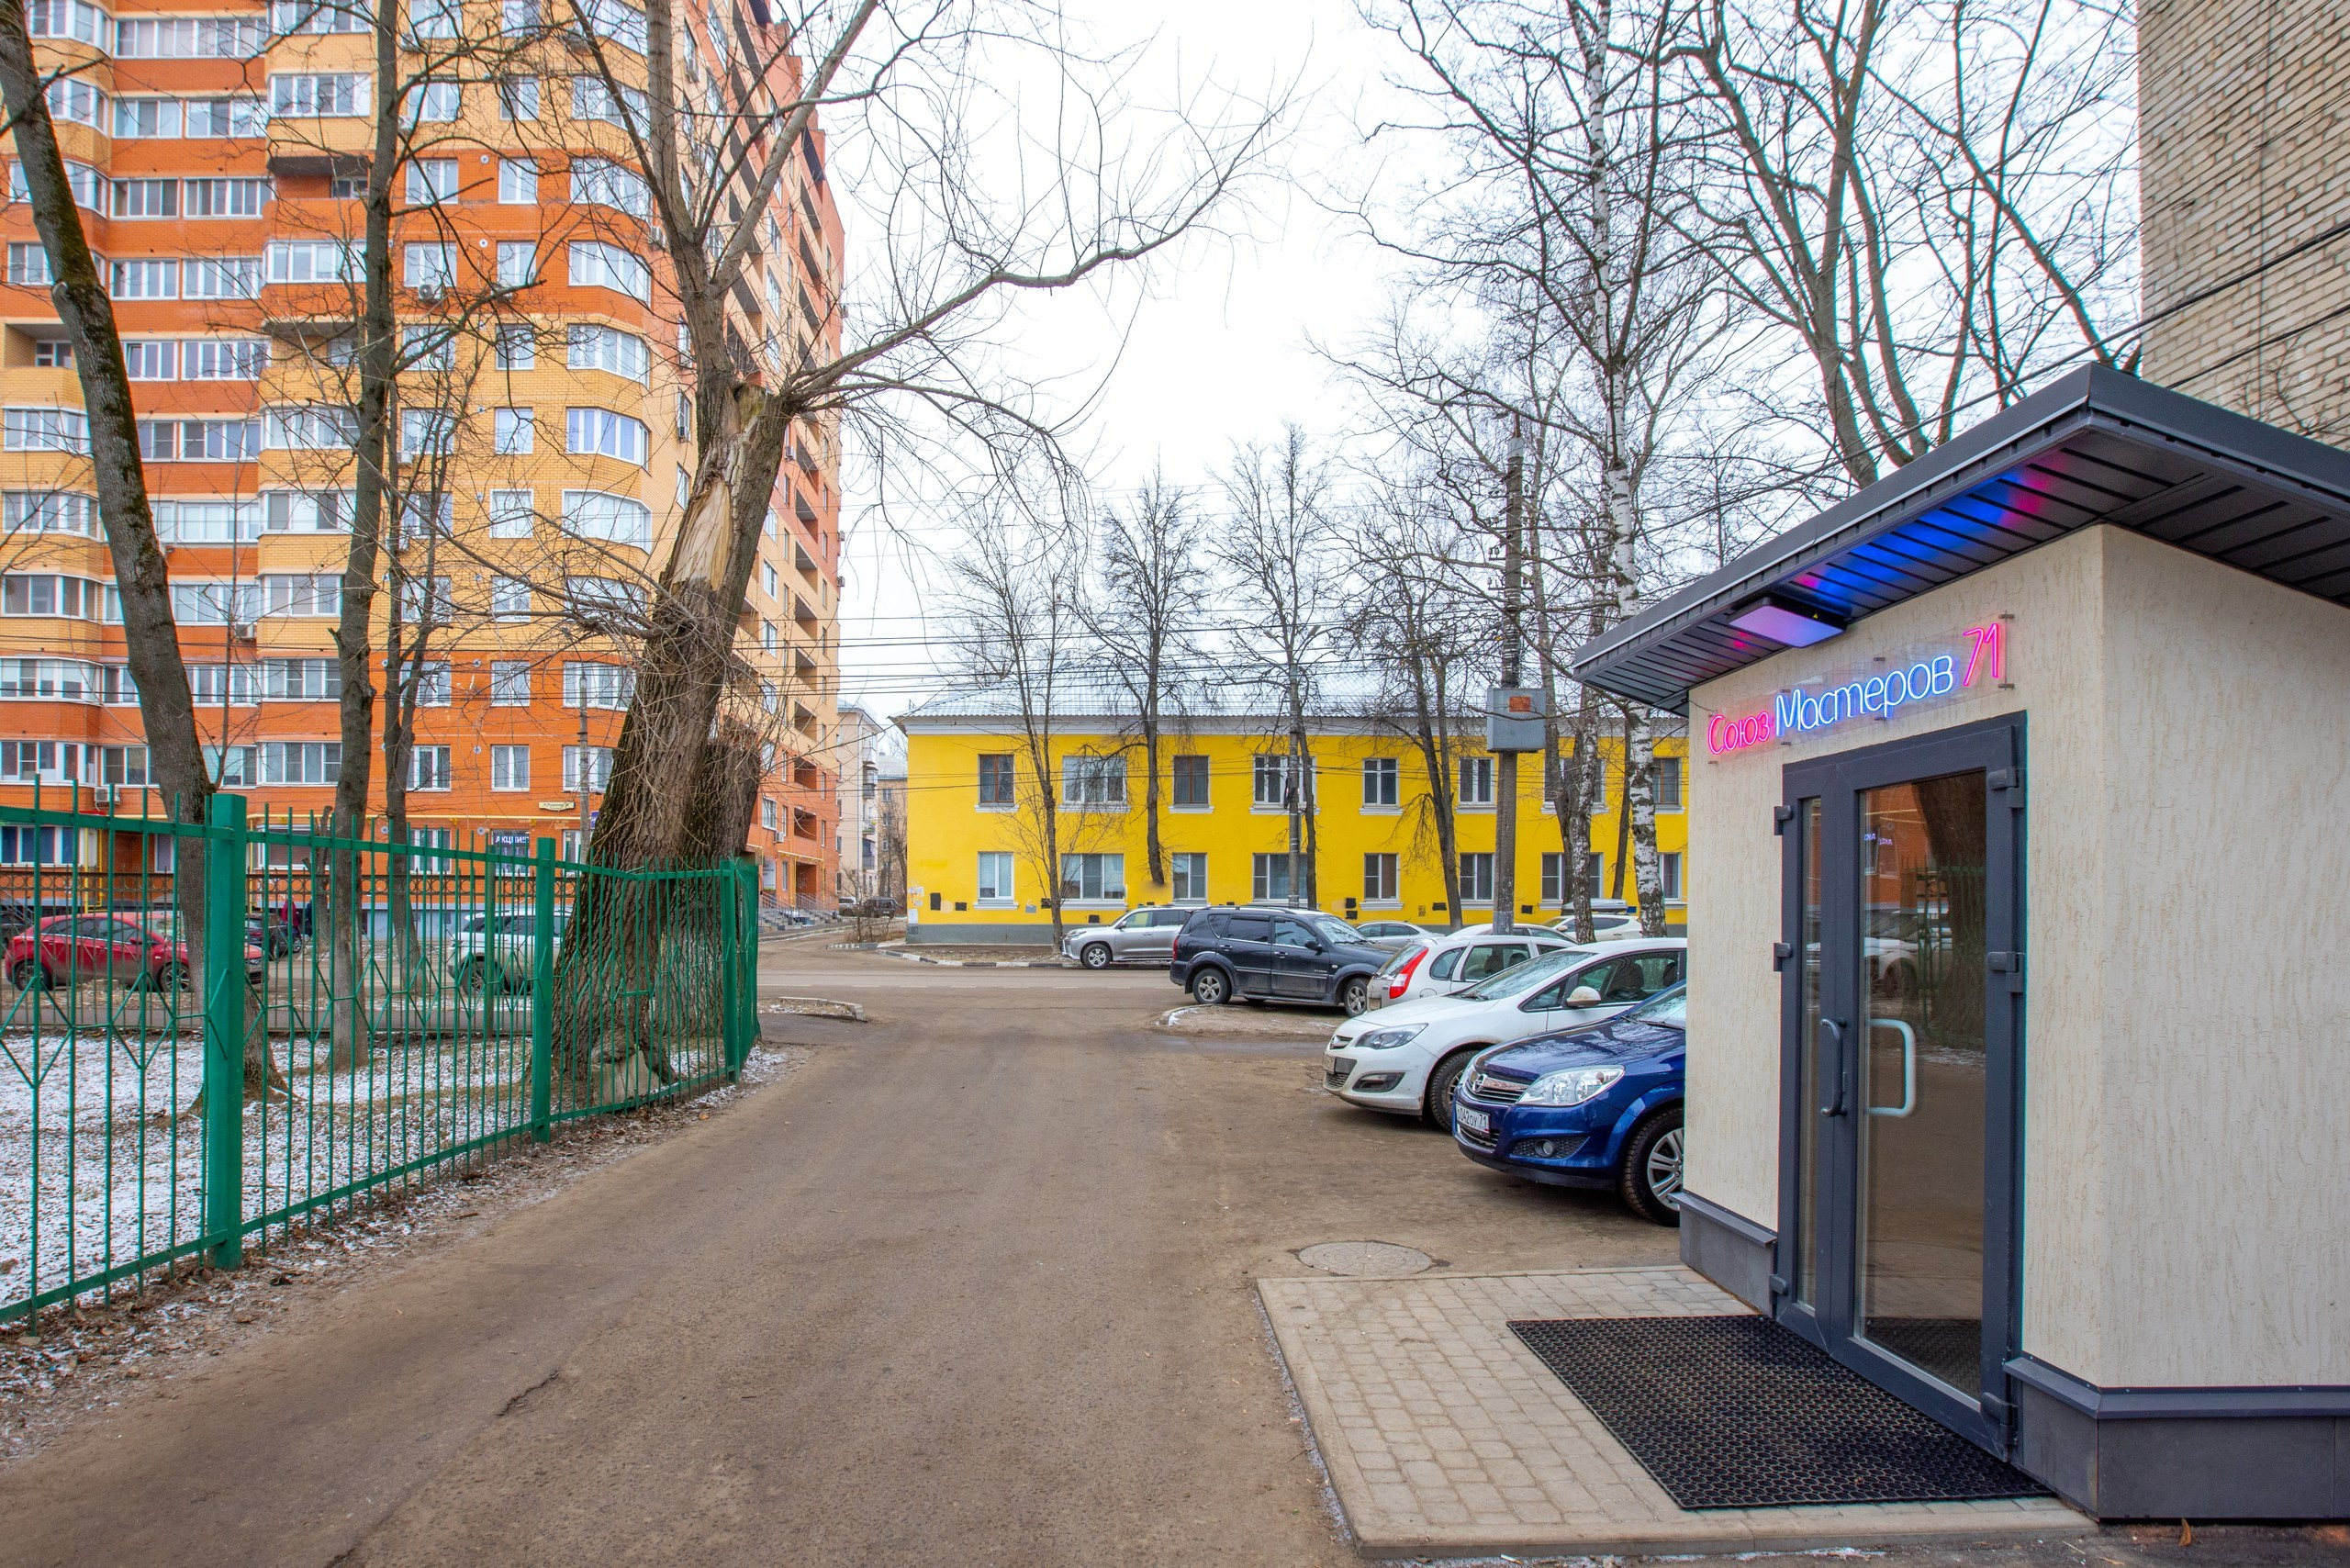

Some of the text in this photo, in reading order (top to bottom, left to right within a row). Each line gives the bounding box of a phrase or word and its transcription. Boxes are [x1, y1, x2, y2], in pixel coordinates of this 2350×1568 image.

[1708, 623, 1999, 754] Союз Мастеров 71
